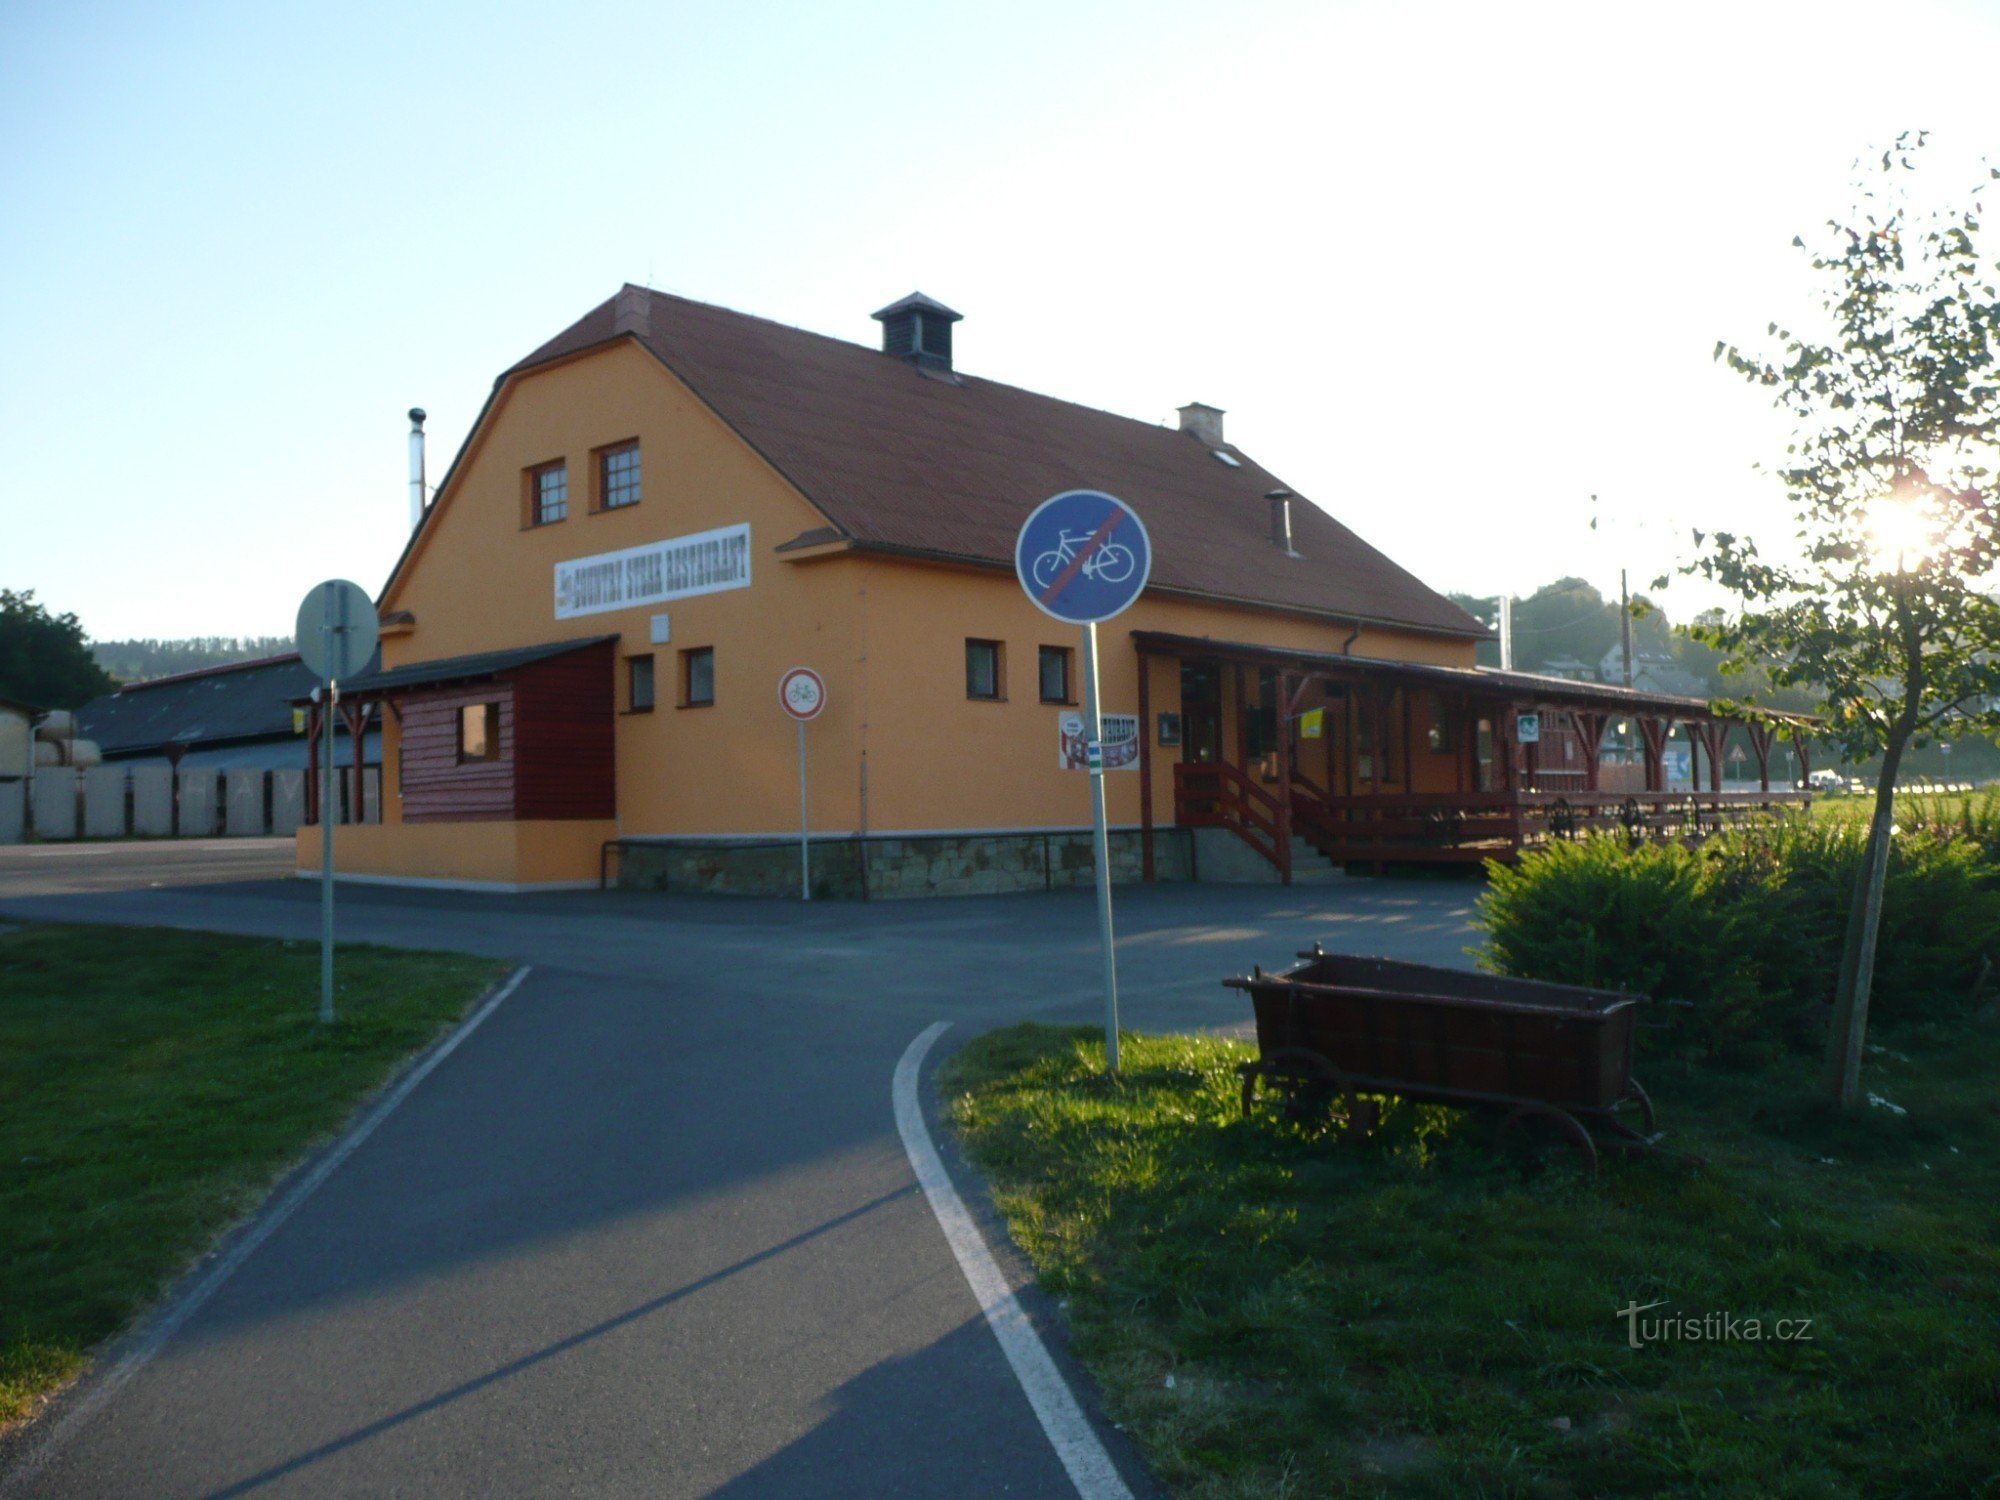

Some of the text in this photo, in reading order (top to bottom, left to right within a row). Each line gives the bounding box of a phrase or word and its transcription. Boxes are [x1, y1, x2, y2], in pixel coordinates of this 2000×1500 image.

[574, 533, 746, 609] COUNTRY STEAK RESTAURANT
